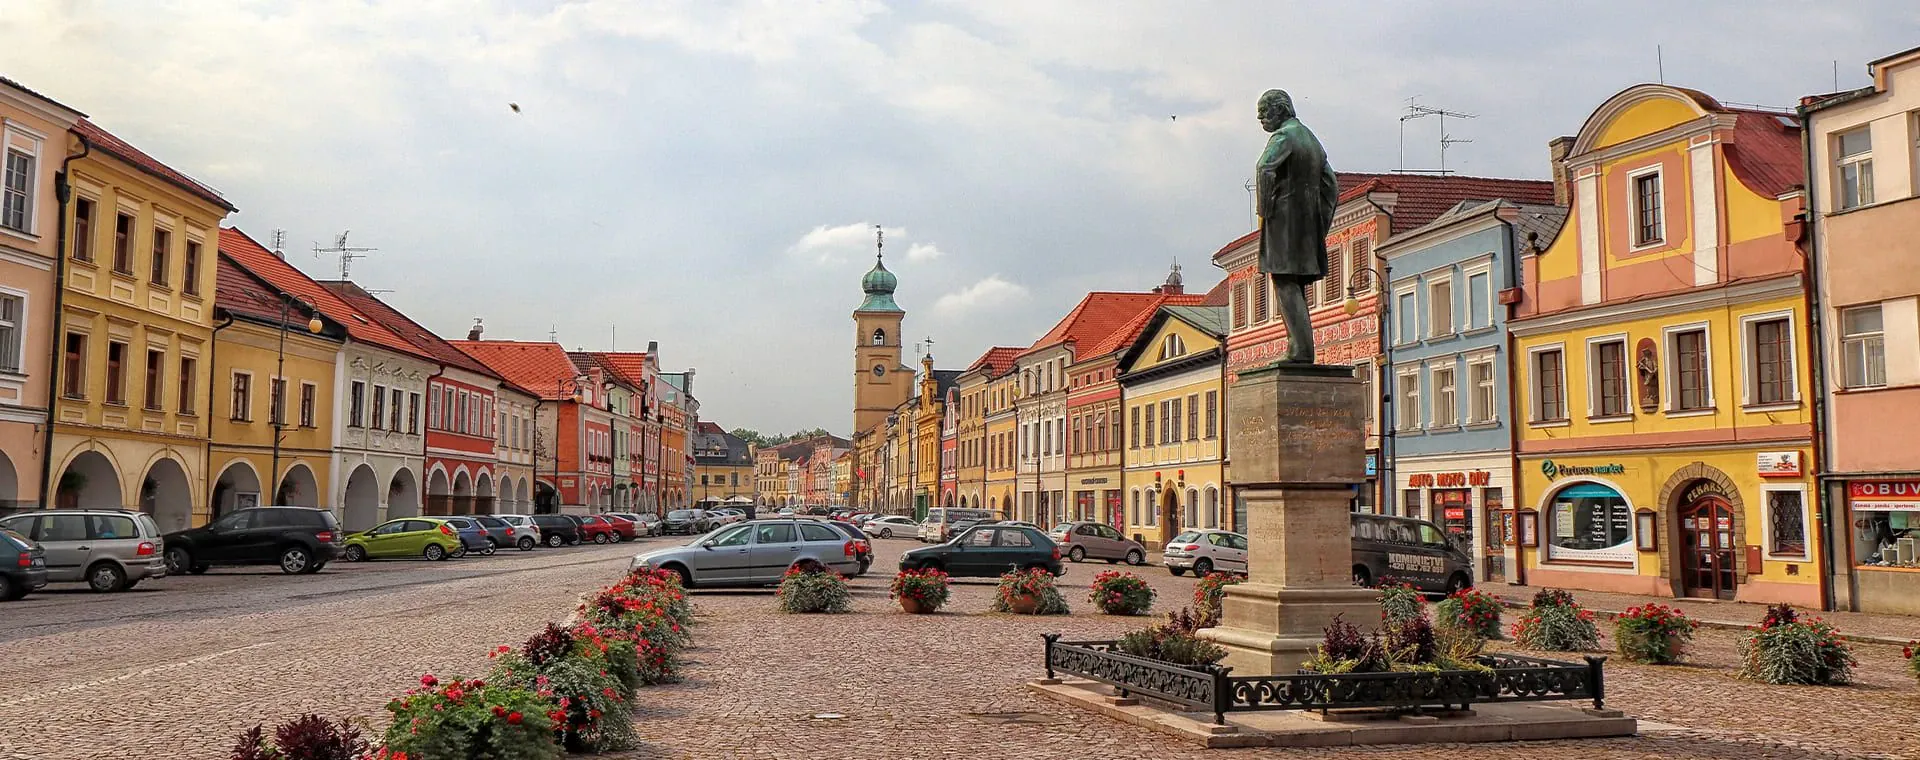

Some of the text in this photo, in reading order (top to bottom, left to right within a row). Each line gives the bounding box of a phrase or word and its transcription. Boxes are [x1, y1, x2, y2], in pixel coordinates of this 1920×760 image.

[1559, 463, 1624, 476] Partners market
[1409, 473, 1434, 487] AUTO
[1437, 472, 1466, 487] MOTO
[1863, 483, 1920, 495] OBUV
